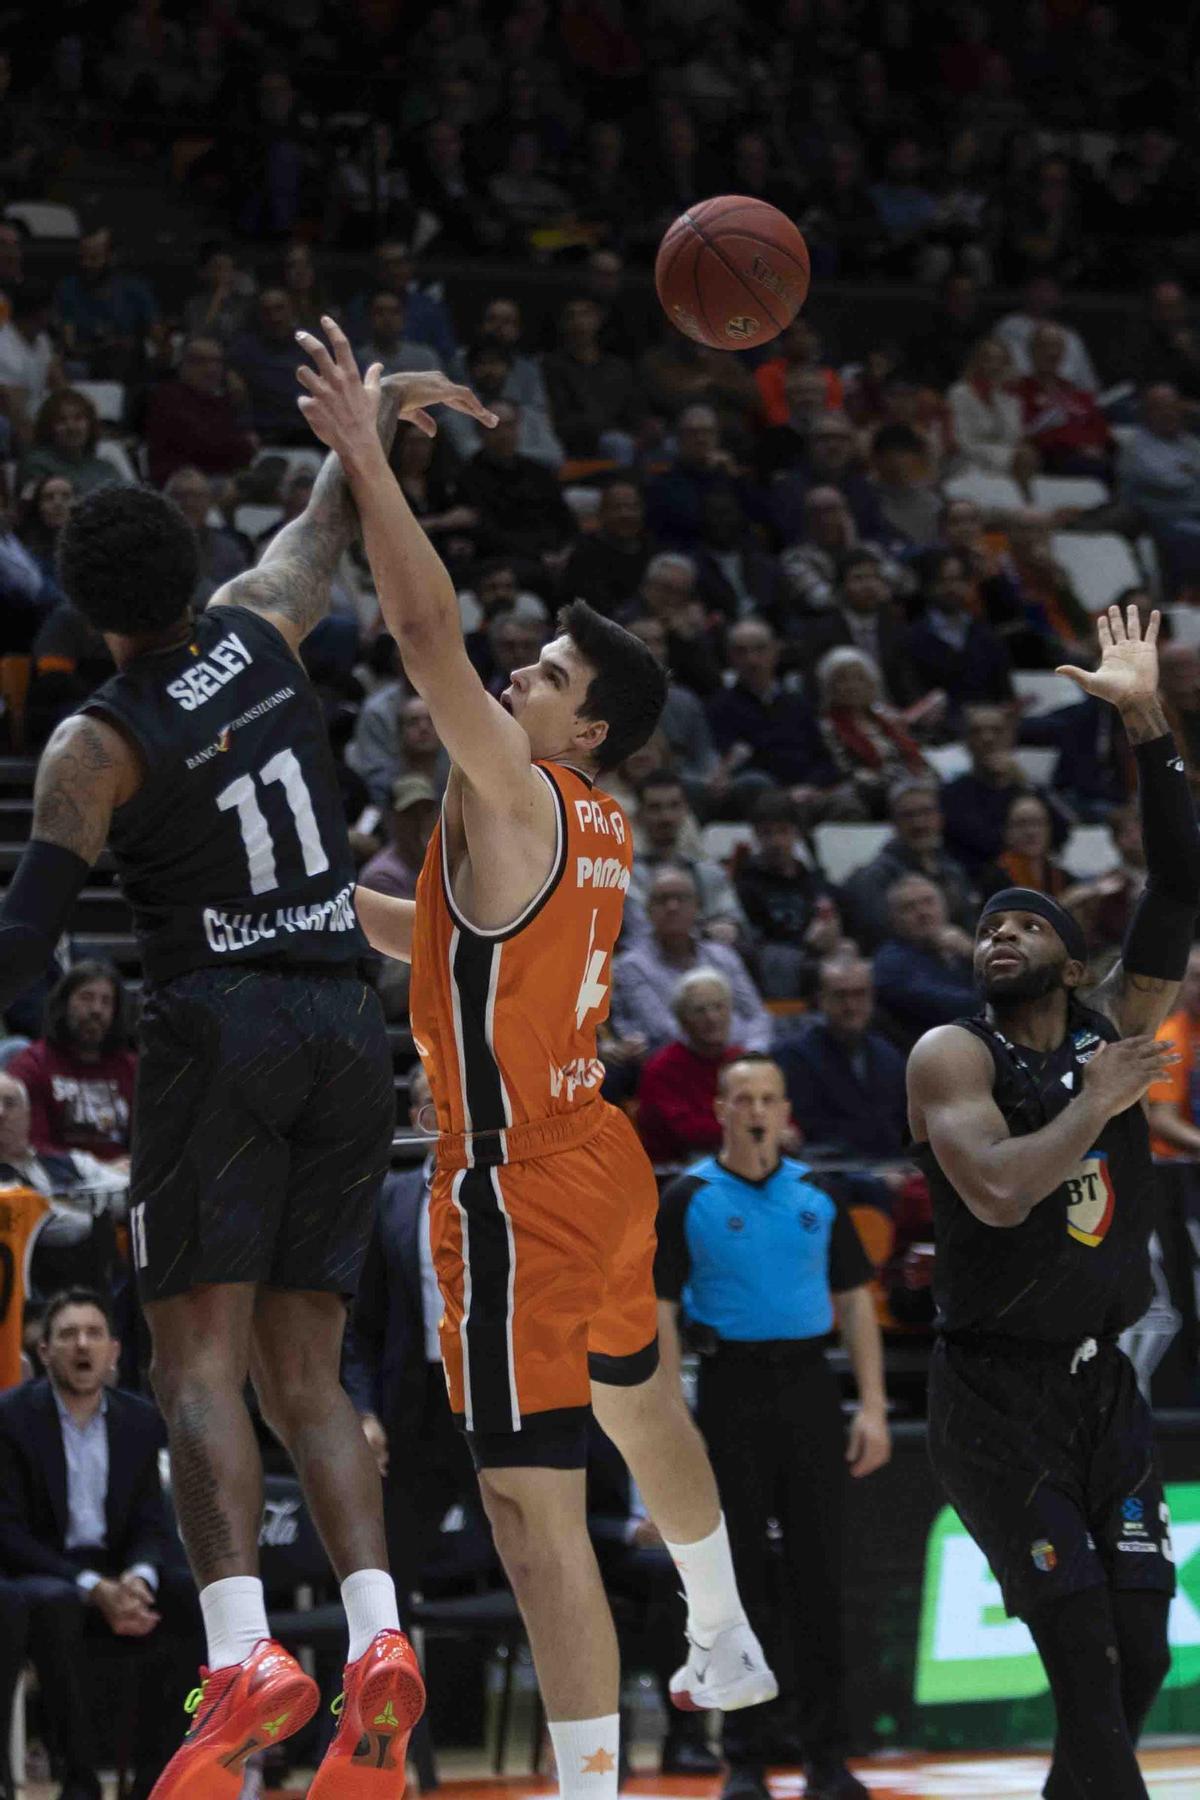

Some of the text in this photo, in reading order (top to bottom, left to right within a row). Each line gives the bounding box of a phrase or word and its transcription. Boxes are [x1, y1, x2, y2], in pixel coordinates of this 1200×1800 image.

[166, 632, 253, 711] SEELEY
[185, 687, 296, 770] BANCA TRANSILVANIA
[215, 748, 330, 895] 11
[1065, 1173, 1098, 1206] BT
